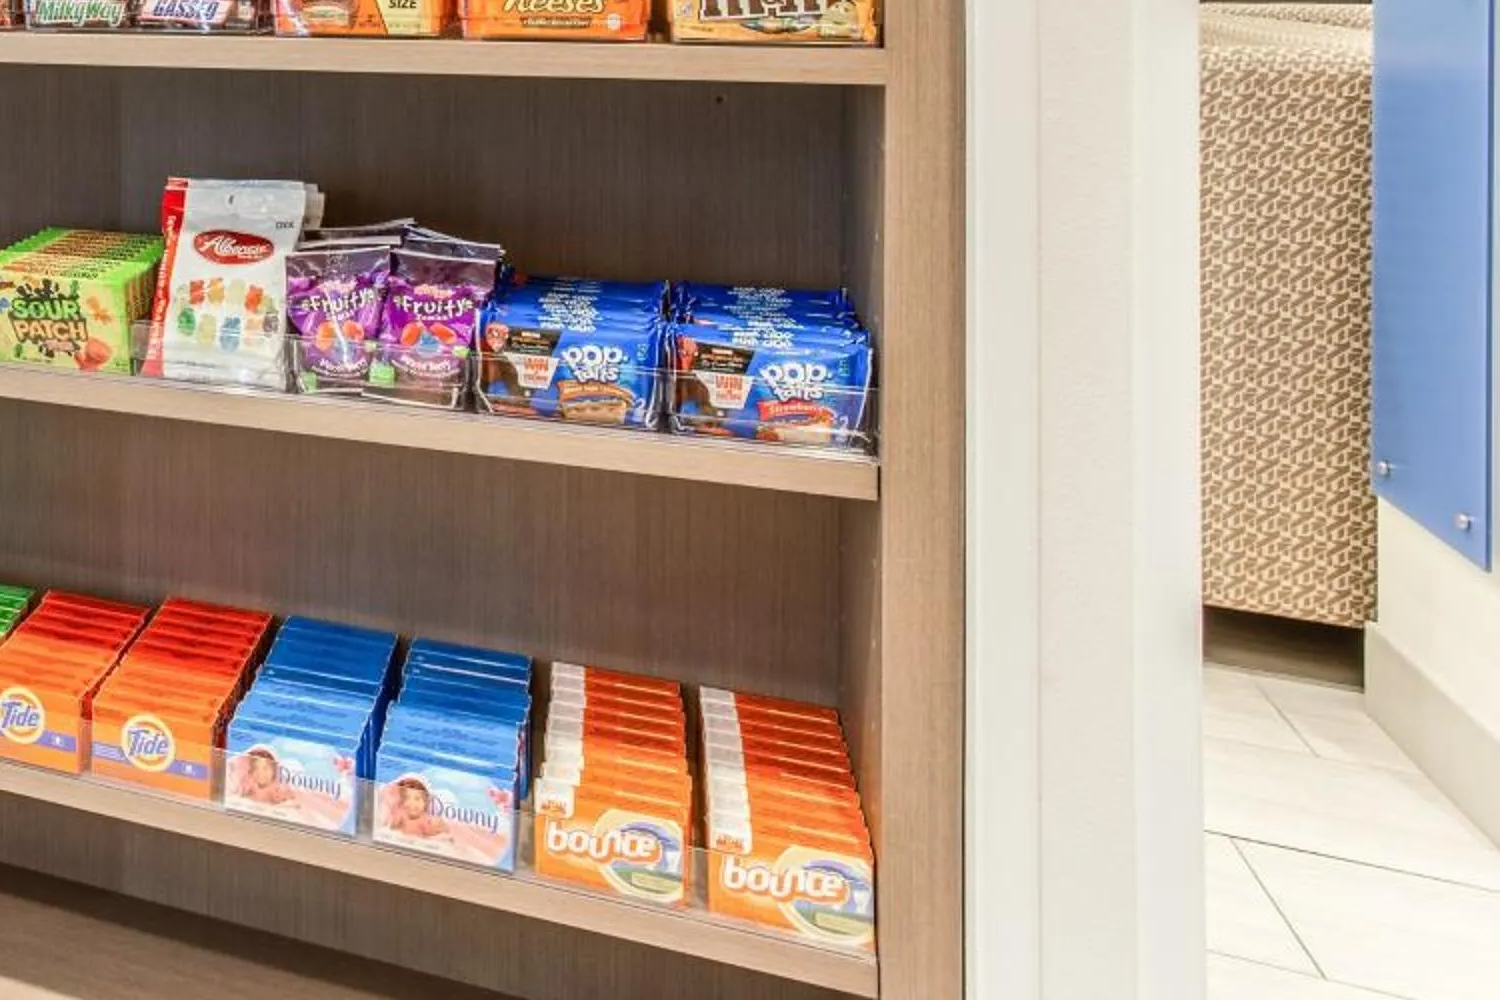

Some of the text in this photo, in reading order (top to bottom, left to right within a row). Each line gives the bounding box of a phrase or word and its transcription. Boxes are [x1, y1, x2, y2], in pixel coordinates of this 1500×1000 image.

[11, 299, 80, 320] SOUR
[309, 286, 369, 313] Fruity
[403, 297, 467, 318] Fruity
[14, 319, 88, 342] PATCH
[0, 701, 40, 729] Tide
[128, 727, 170, 758] Tide
[279, 764, 342, 800] Downy
[431, 795, 499, 834] Downy
[548, 818, 656, 860] bounce
[723, 854, 842, 899] bounce
